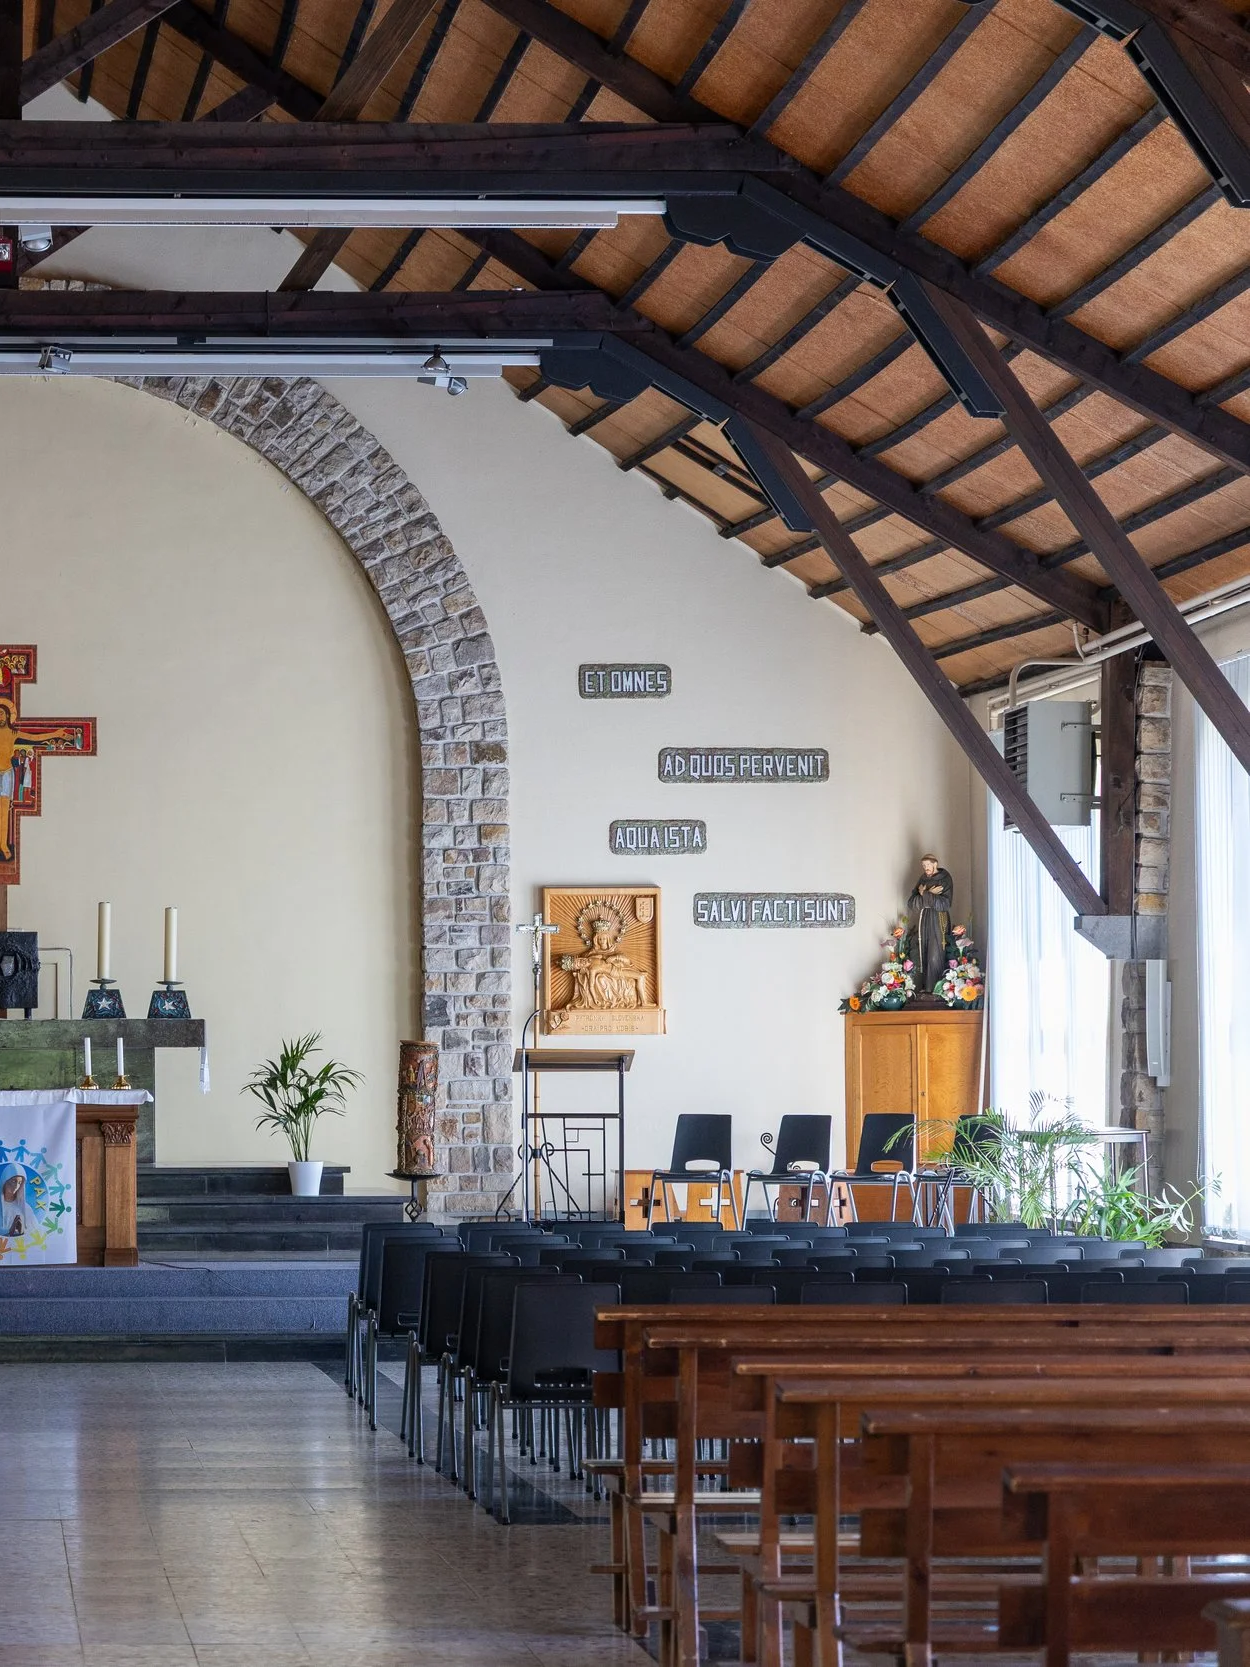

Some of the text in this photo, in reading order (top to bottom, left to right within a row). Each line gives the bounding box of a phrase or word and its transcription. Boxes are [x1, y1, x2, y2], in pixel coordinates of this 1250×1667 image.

[584, 671, 667, 693] ET OMNES
[662, 755, 824, 779] AD QUOS PERVENIT
[614, 826, 703, 850] AQUA ISTA
[697, 900, 850, 922] SALVI FACTI SUNT
[30, 1176, 48, 1211] PAX
